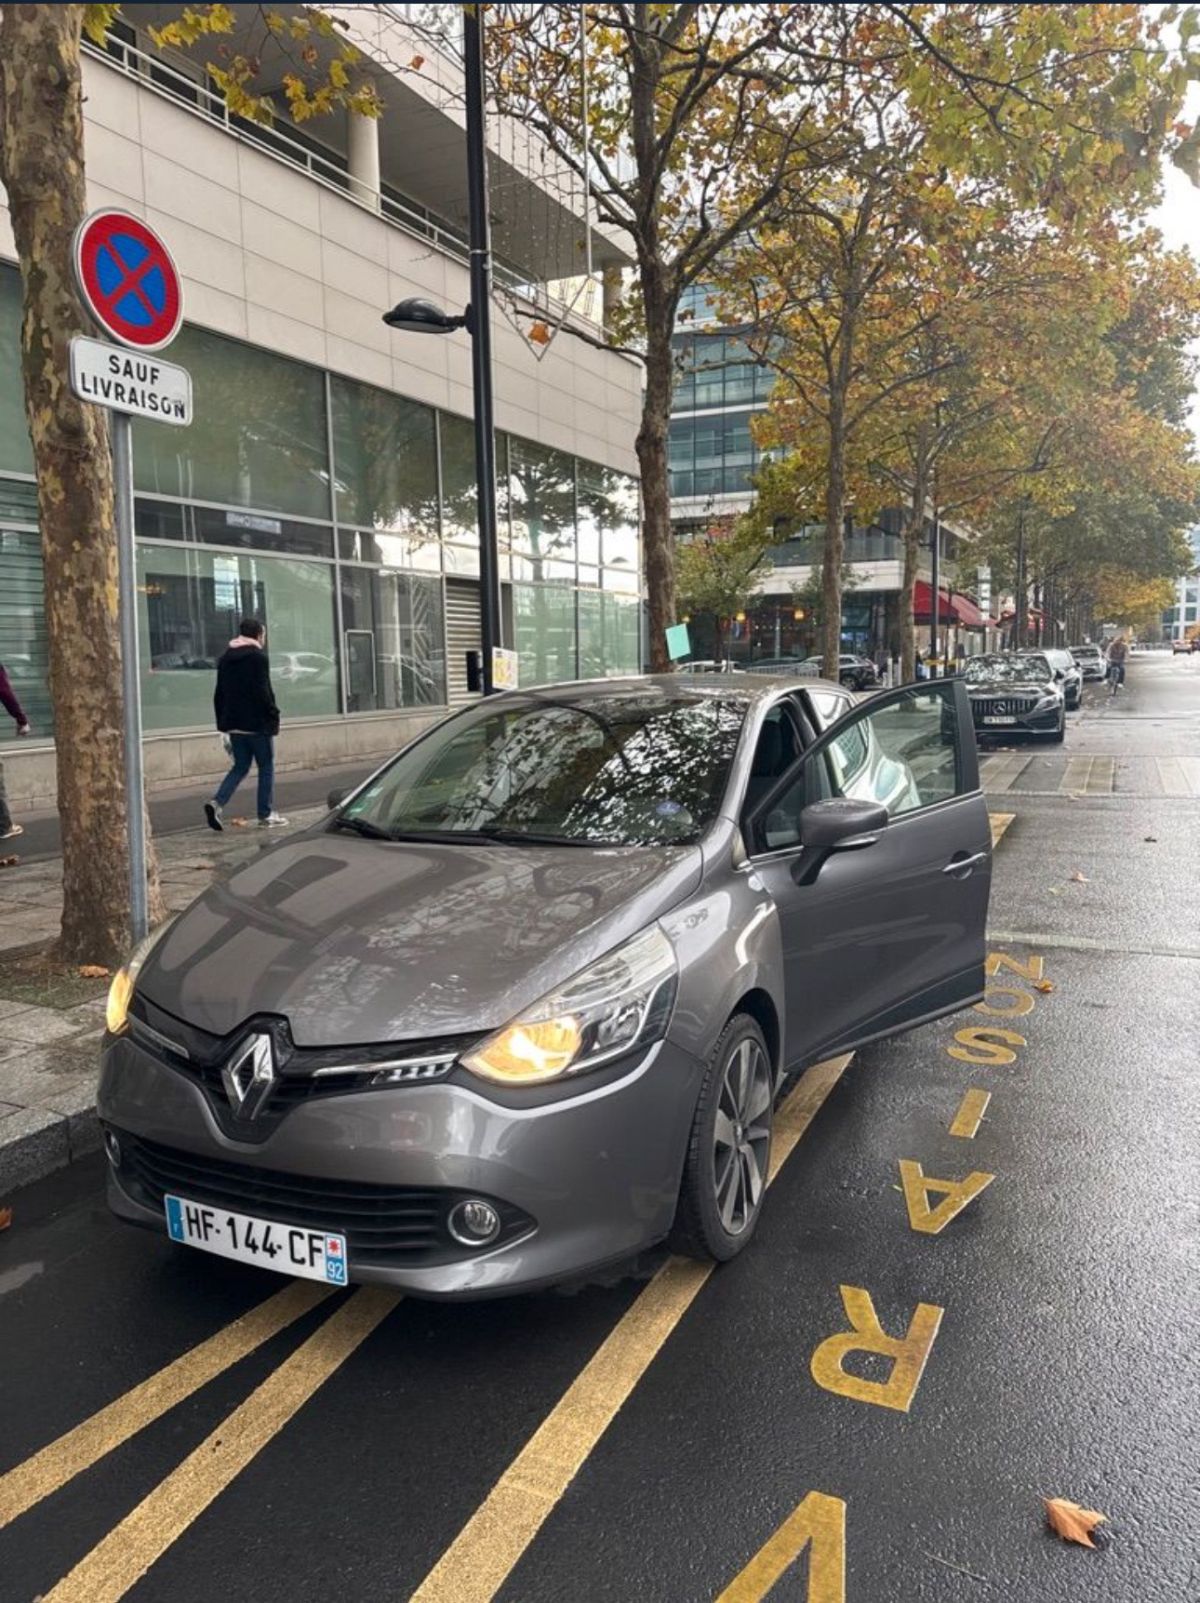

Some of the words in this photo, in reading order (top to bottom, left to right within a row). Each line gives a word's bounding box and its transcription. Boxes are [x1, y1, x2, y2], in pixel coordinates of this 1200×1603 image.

[108, 354, 160, 386] SAUF
[81, 372, 186, 420] LIVRAISON
[185, 1205, 324, 1267] HF-144-CF
[327, 1261, 344, 1280] 92
